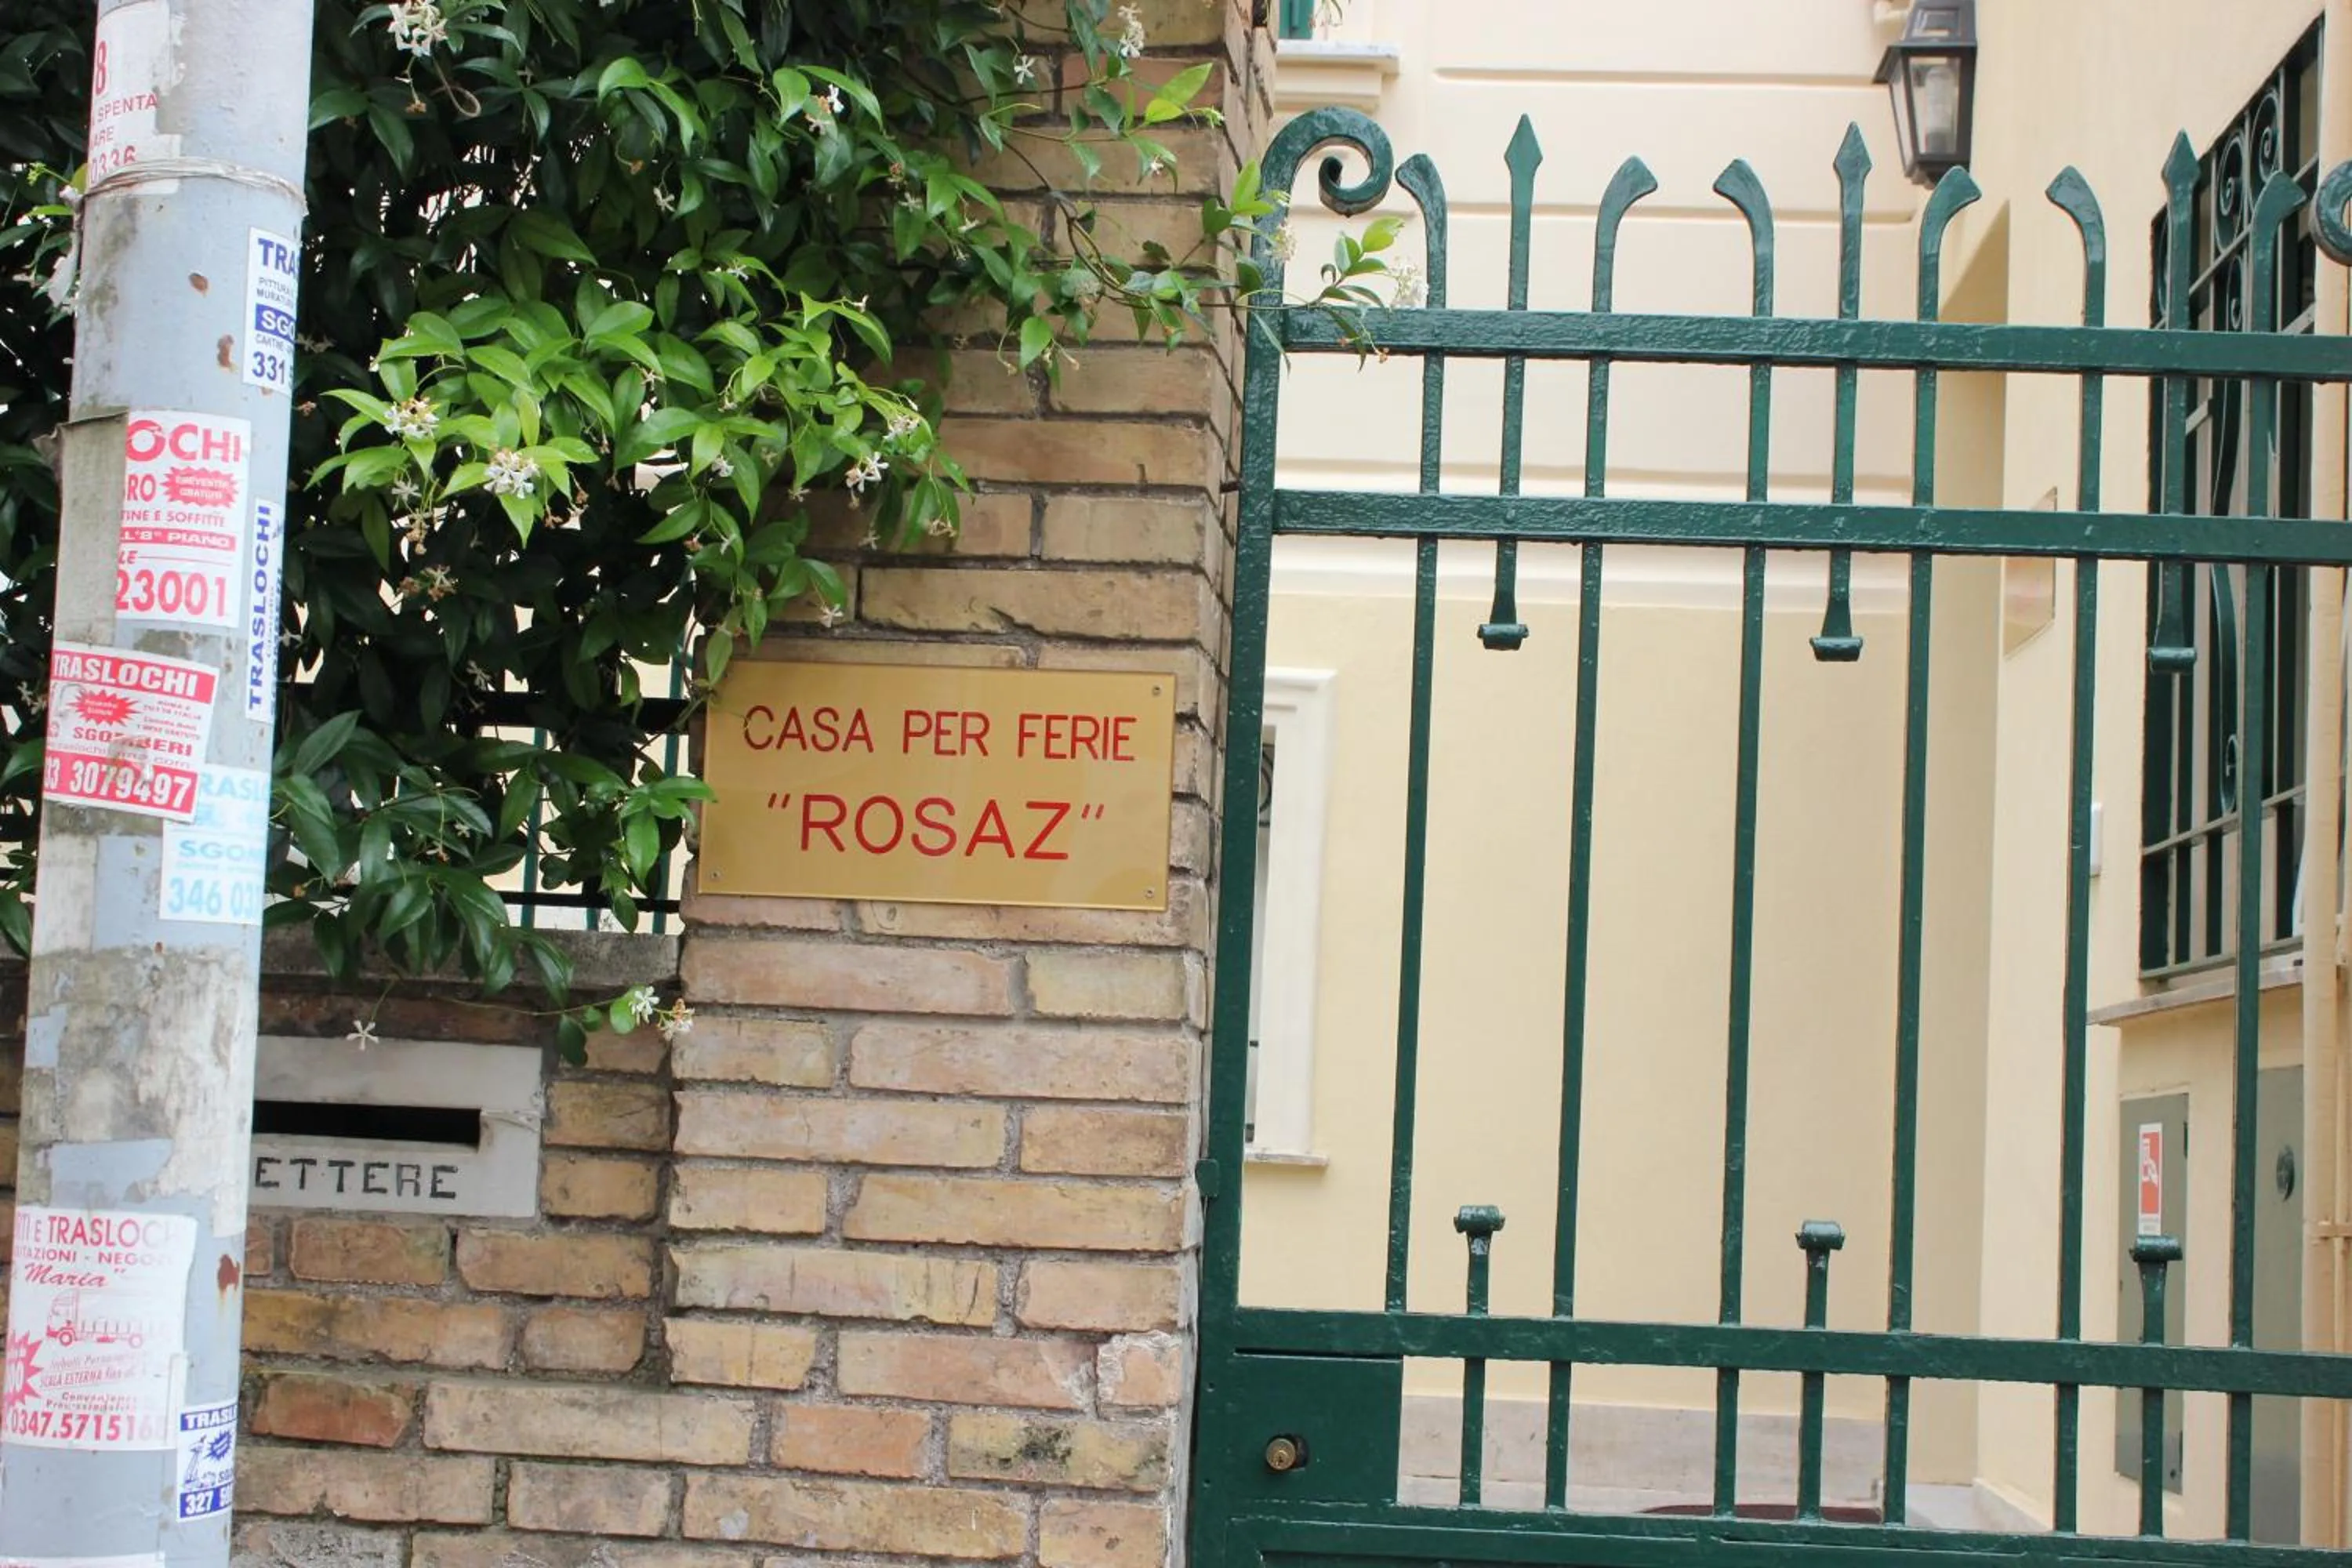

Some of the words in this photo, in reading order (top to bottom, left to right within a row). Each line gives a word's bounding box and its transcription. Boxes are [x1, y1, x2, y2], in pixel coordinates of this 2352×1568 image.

[98, 93, 159, 122] SPENTA
[252, 350, 285, 384] 331
[125, 419, 240, 462] OCHI
[154, 510, 162, 521] E
[168, 532, 230, 546] PIANO
[115, 569, 226, 617] 23001
[249, 506, 272, 710] TRASLOCHI
[53, 654, 198, 697] TRASLOCHI
[743, 705, 875, 753] CASA
[902, 710, 991, 757] PER
[1017, 713, 1138, 761] FERIE
[70, 761, 192, 808] 3079497
[767, 792, 1105, 860] "ROSAZ"
[168, 877, 222, 916] 346
[254, 1156, 459, 1200] ETTERE
[24, 1262, 107, 1287] Maria
[185, 1490, 214, 1516] 327
